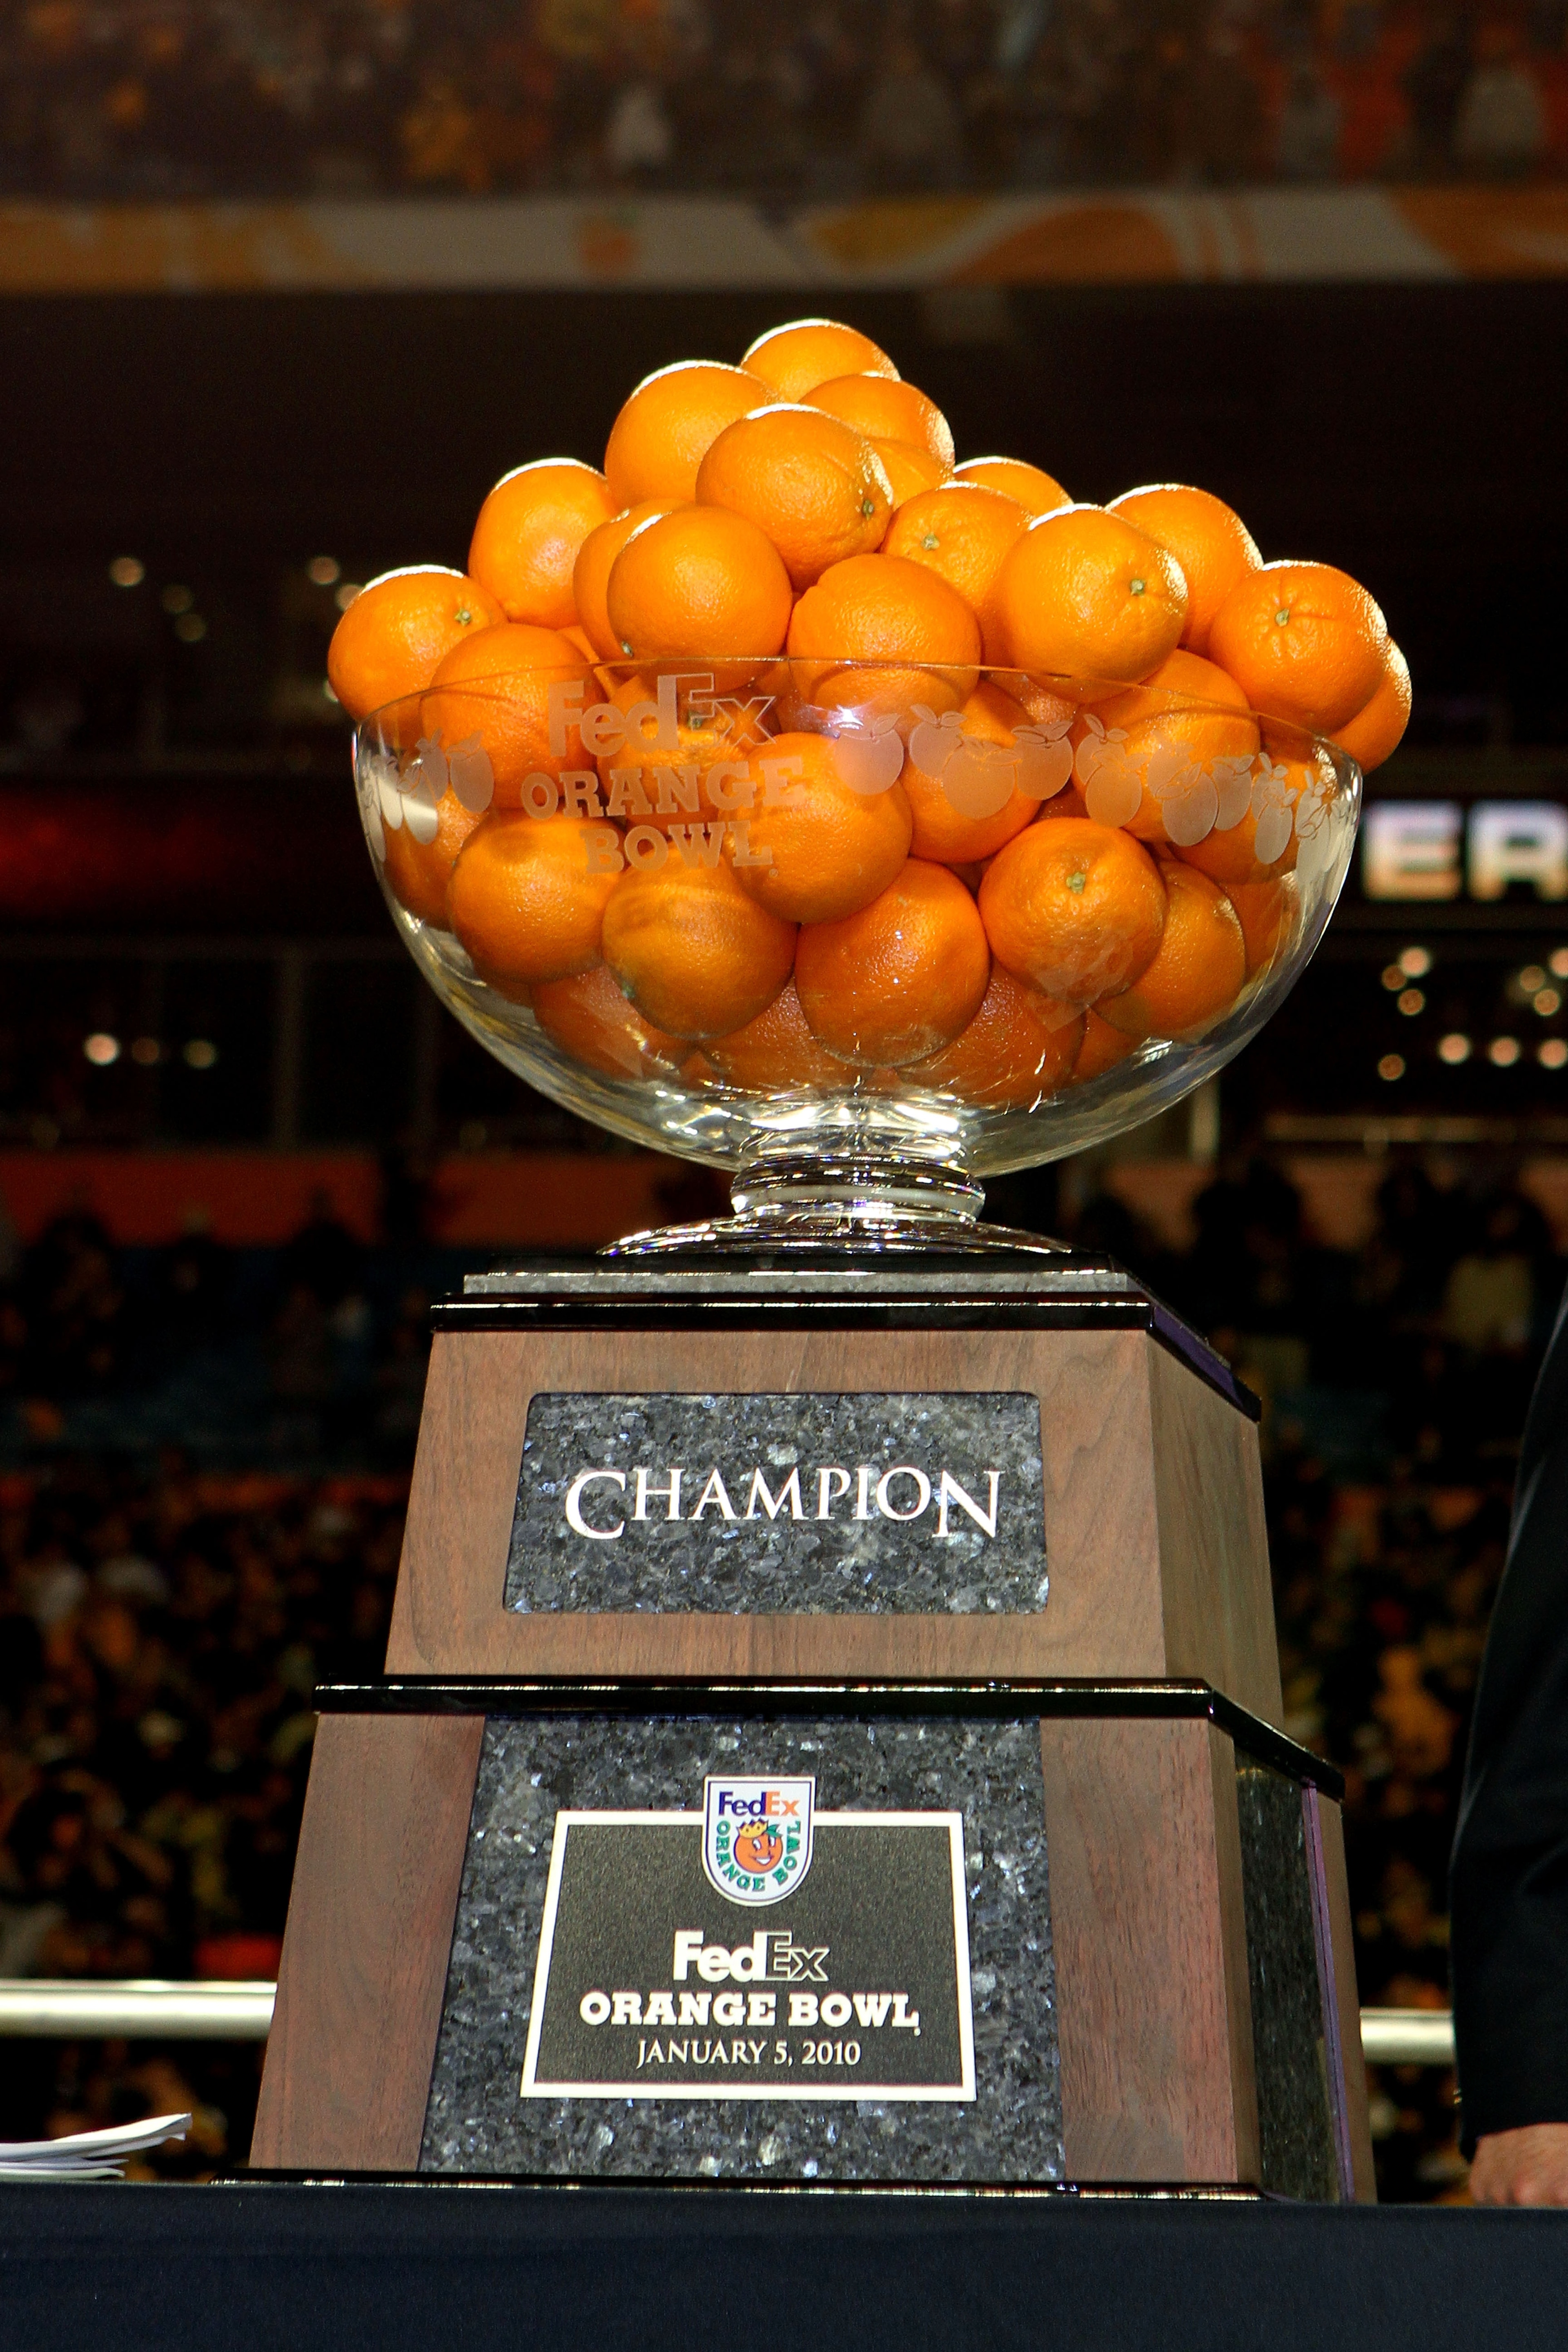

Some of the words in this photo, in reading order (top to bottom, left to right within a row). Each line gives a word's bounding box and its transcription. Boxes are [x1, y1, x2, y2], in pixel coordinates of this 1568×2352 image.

[548, 672, 777, 757] FedEx
[520, 756, 806, 820] ORANGE
[579, 820, 774, 875] BOWL
[565, 1466, 1005, 1539] CHAMPION
[719, 1791, 800, 1816] FedEx
[716, 1820, 766, 1892] ORANGE
[772, 1820, 801, 1887] BOWL
[673, 1930, 830, 1982] FedEx
[579, 1991, 776, 2027] ORANGE
[637, 2039, 766, 2069] JANUARY
[774, 2040, 793, 2067] 5,
[801, 2040, 862, 2065] 2010
